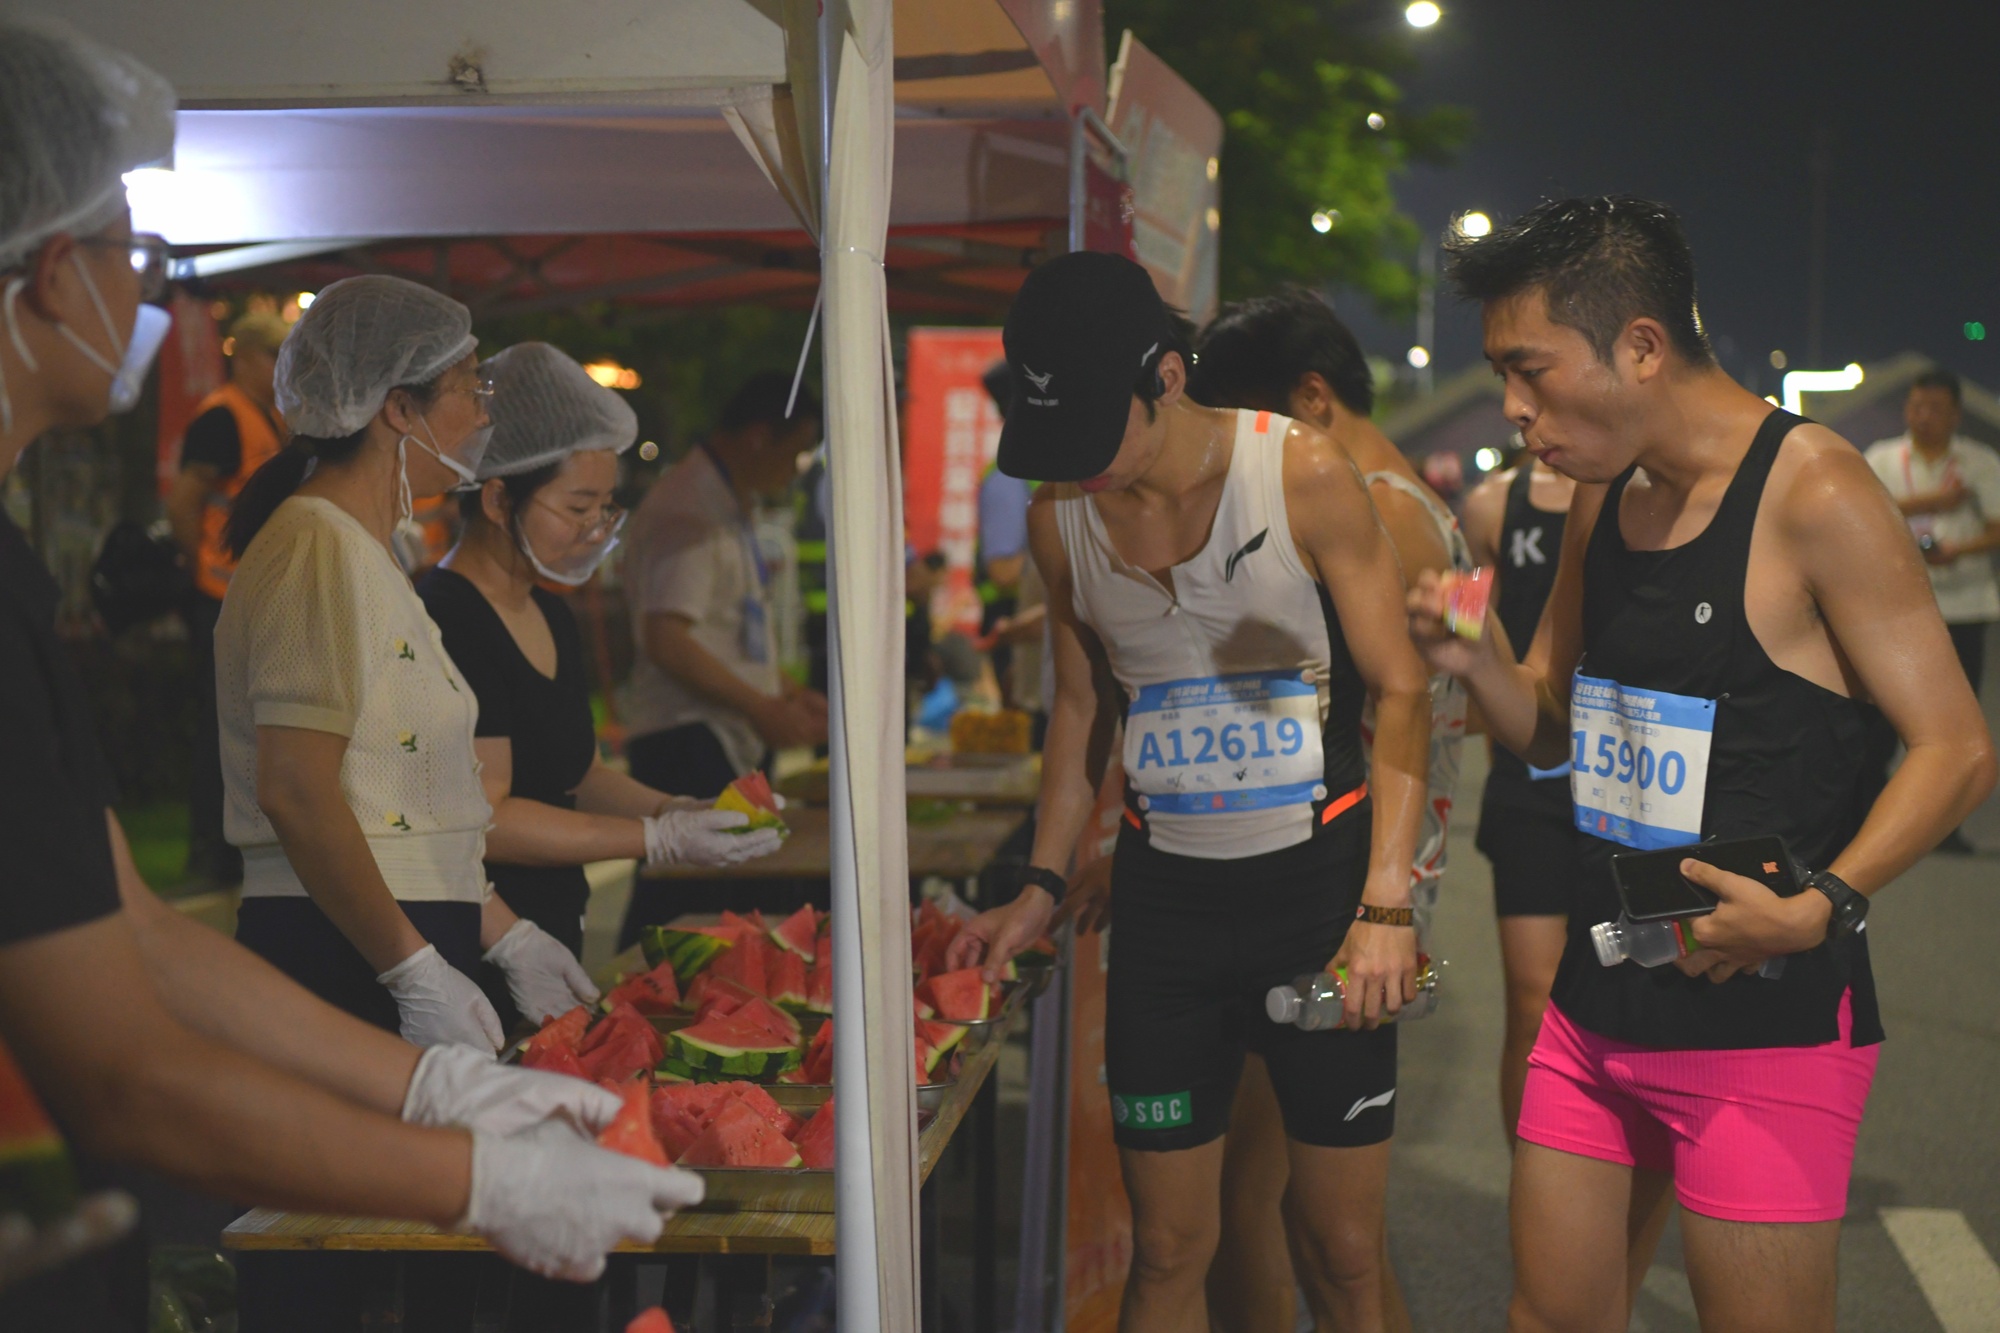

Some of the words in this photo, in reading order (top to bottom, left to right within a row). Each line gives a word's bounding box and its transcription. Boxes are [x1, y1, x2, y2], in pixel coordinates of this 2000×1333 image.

[1512, 527, 1545, 567] K
[1137, 717, 1303, 770] A12619
[1572, 730, 1686, 795] 15900
[1135, 1099, 1182, 1123] SGC
